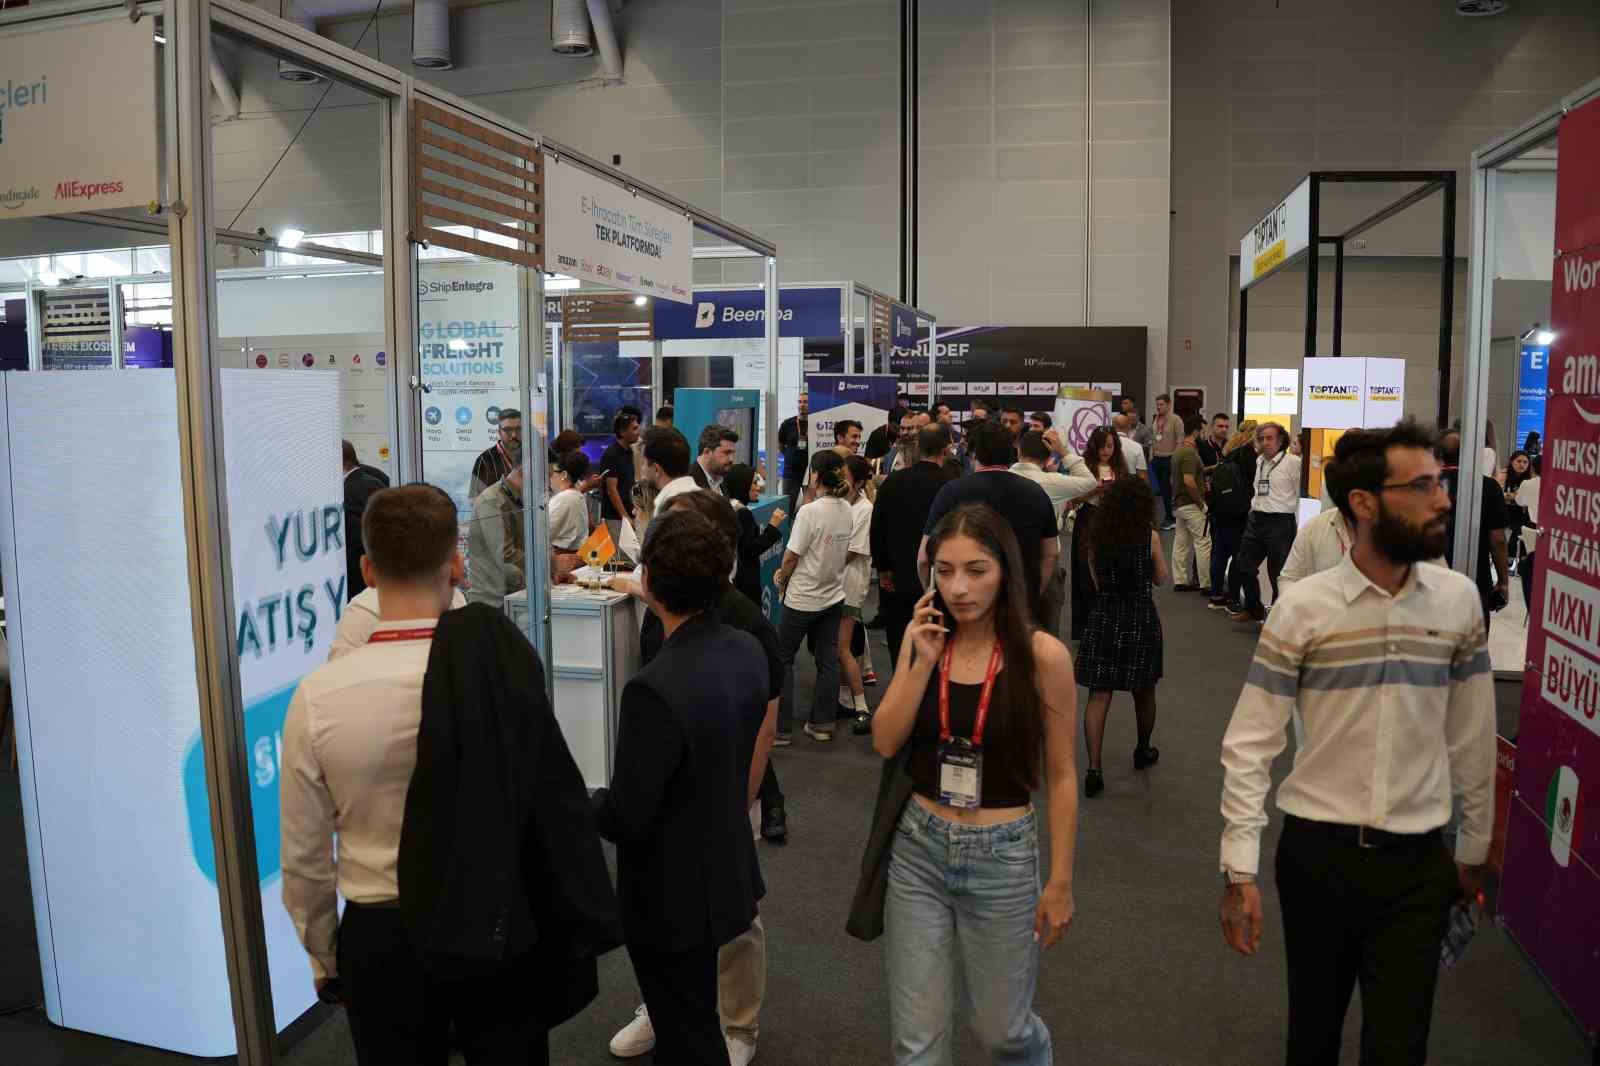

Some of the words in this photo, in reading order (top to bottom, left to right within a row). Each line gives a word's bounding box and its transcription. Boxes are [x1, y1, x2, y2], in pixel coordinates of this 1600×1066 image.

[55, 181, 124, 200] AliExpress
[595, 223, 611, 243] TEK
[612, 229, 662, 259] PLATFORMDA!
[429, 280, 494, 294] ShipEntegra
[421, 320, 504, 340] GLOBAL
[422, 341, 504, 360] FREIGHT
[423, 362, 505, 376] SOLUTIONS
[1562, 354, 1600, 395] am
[1309, 385, 1360, 394] TOPTANTR
[1554, 484, 1600, 535] SATIŞ
[265, 505, 346, 568] YUR
[1548, 586, 1593, 642] MXN
